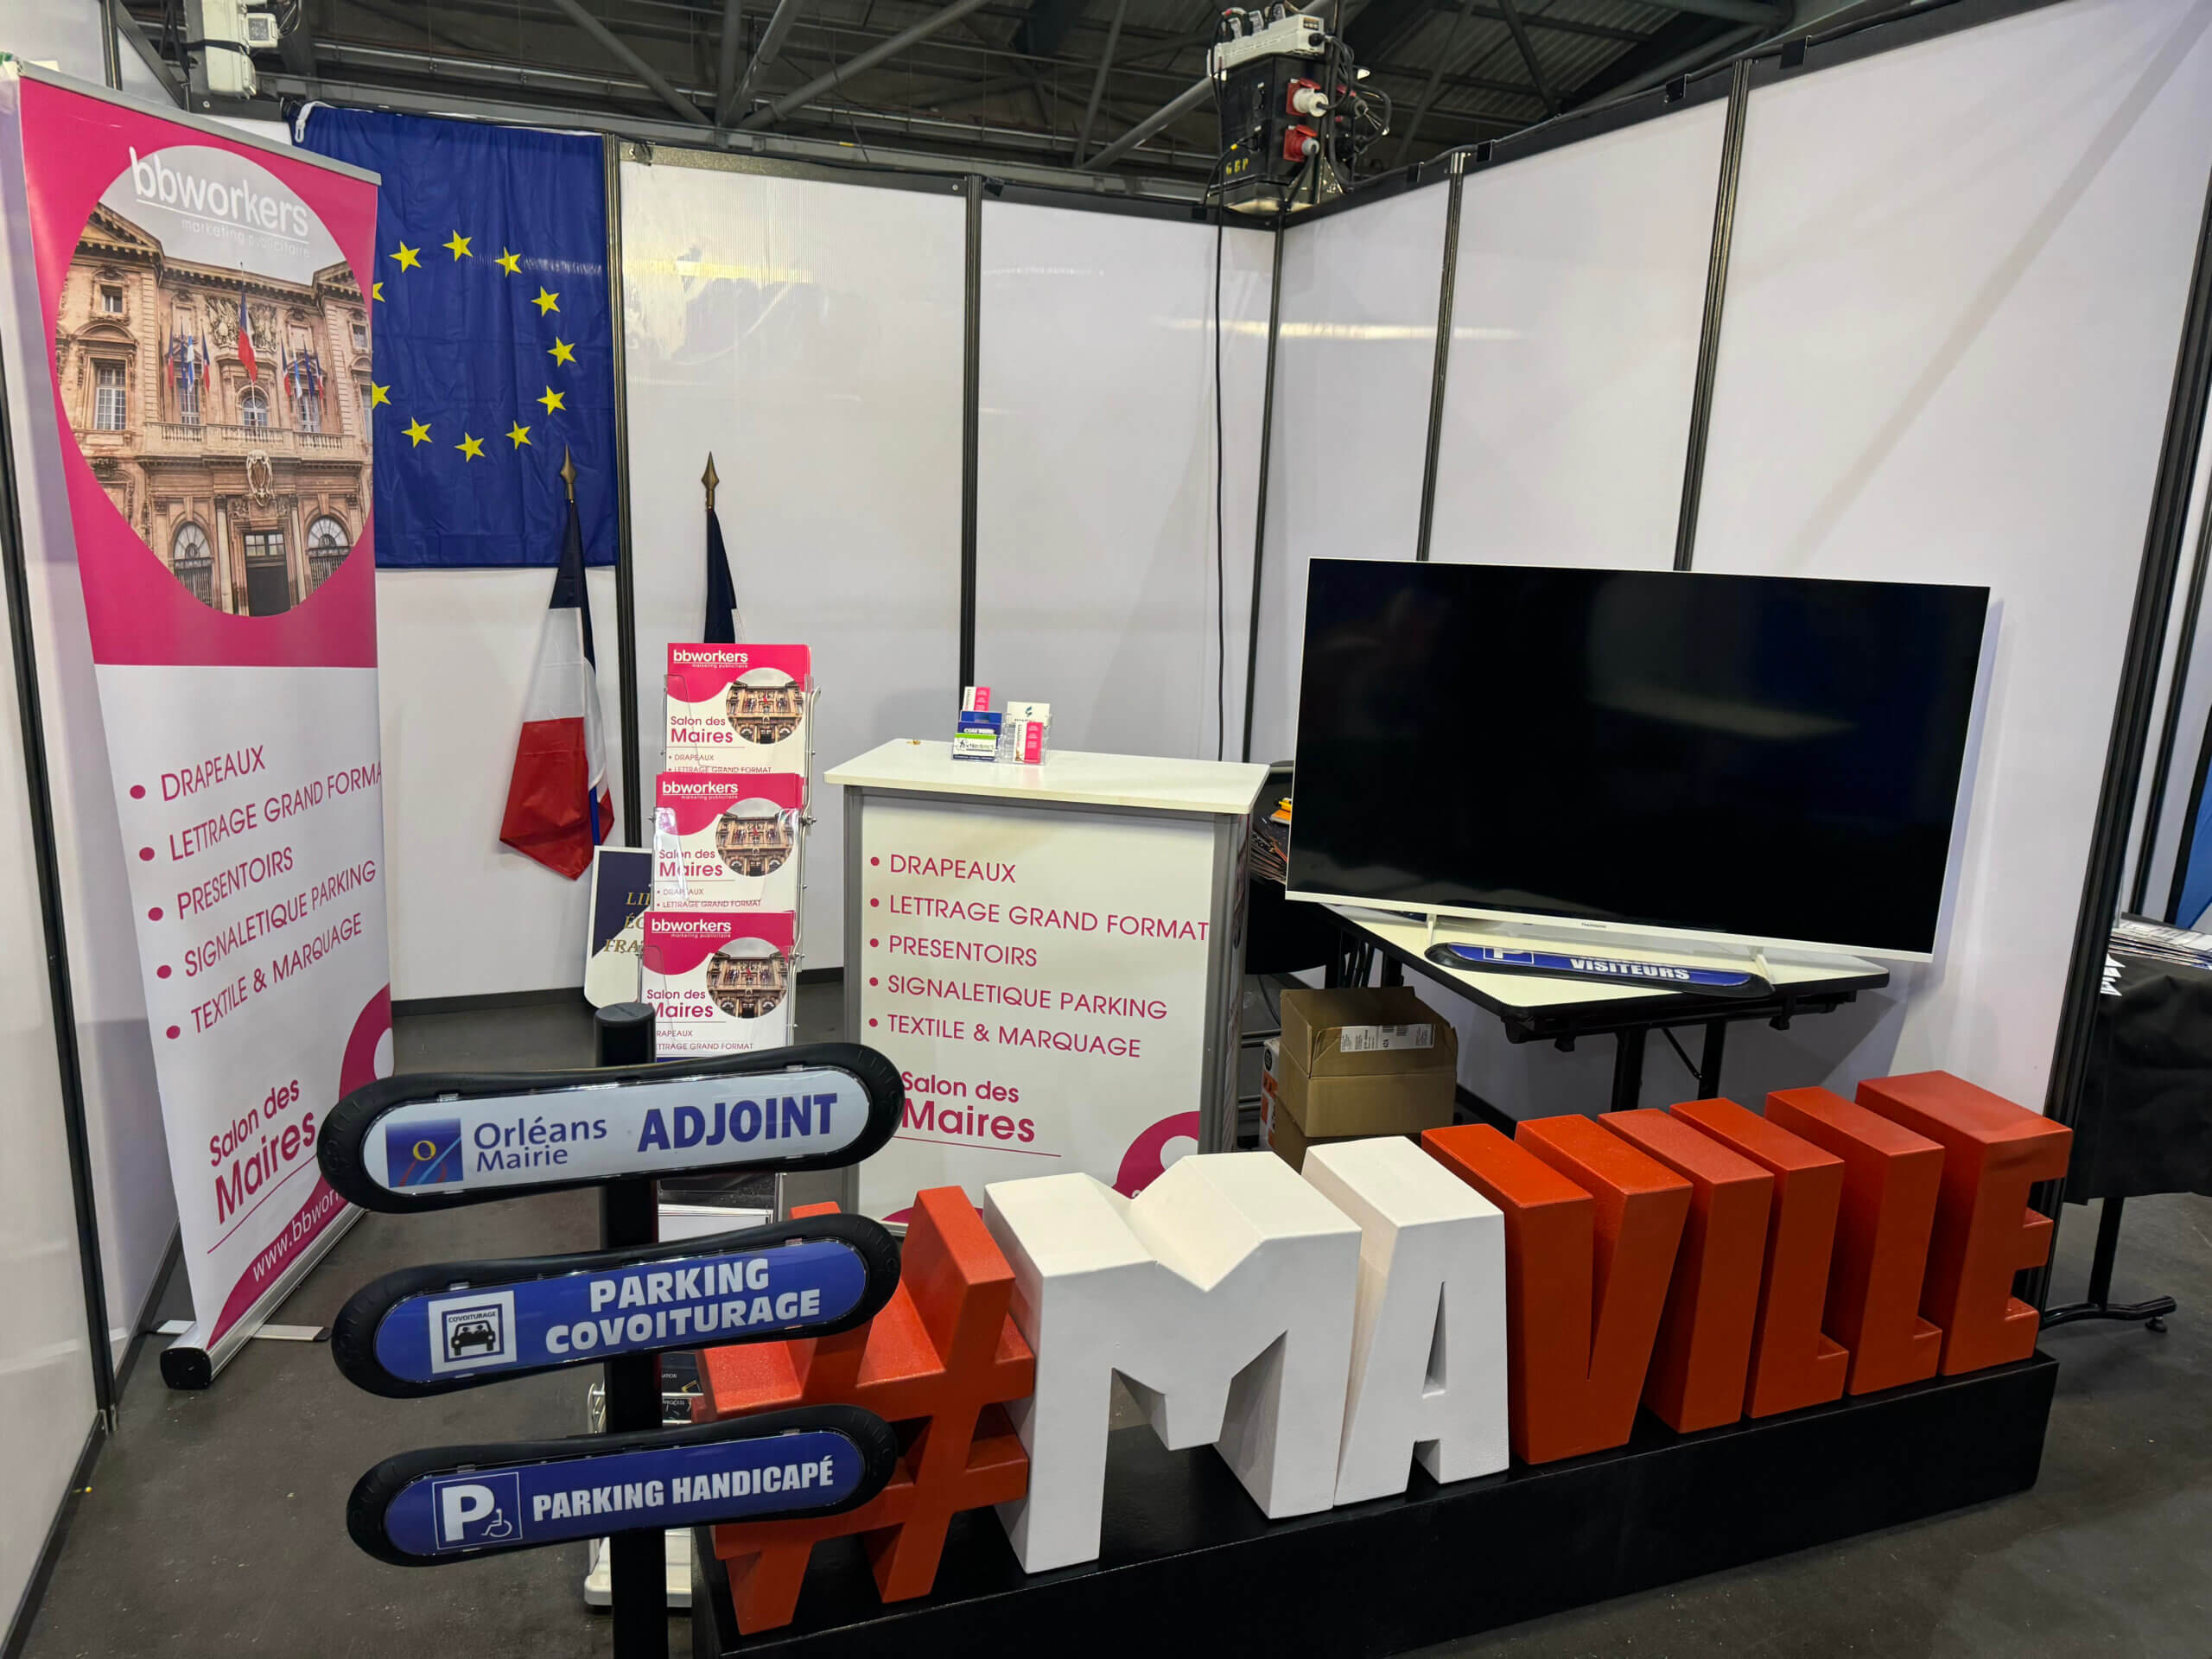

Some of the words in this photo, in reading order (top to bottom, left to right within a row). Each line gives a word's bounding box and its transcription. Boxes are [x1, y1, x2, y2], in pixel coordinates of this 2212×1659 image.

[130, 146, 308, 237] bbworkers
[673, 649, 748, 662] bbworkers
[671, 715, 702, 726] Salon
[706, 715, 726, 726] des
[671, 728, 733, 743] Maires
[161, 745, 265, 802] DRAPEAUX
[662, 780, 739, 793] bbworkers
[169, 803, 257, 861] LETTRAGE
[264, 780, 323, 823] GRAND
[695, 849, 715, 859] des
[890, 854, 1016, 884] DRAPEAUX
[177, 846, 294, 920] PRESENTOIRS
[184, 893, 308, 977] SIGNALETIQUE
[311, 860, 376, 912] PARKING
[652, 918, 731, 931] bbworkers
[890, 895, 1000, 923] LETTRAGE
[1008, 906, 1098, 931] GRAND
[1107, 914, 1209, 941] FORMAT
[190, 976, 248, 1033] TEXTILE
[253, 968, 268, 994] &
[272, 912, 362, 983] MARQUAGE
[890, 935, 1037, 967] PRESENTOIRS
[1569, 958, 1690, 981] VISITEURS
[647, 989, 680, 999] Salon
[683, 989, 706, 999] des
[887, 975, 1052, 1010] SIGNALETIQUE
[1060, 993, 1167, 1020] PARKING
[887, 1014, 965, 1039] TEXTILE
[973, 1024, 989, 1042] &
[999, 1026, 1141, 1058] MARQUAGE
[901, 1071, 967, 1097] Salon
[976, 1081, 1020, 1103] des
[210, 1108, 259, 1167] Salon
[264, 1079, 300, 1120] des
[474, 1116, 607, 1149] Orléans
[637, 1092, 838, 1153] ADJOINT
[901, 1098, 1036, 1143] Maires
[215, 1112, 316, 1224] Maires
[477, 1145, 569, 1173] Mairie
[252, 1188, 340, 1282] www.bbwor
[589, 1257, 769, 1313] PARKING
[448, 1311, 496, 1323] COVOITURAGE
[545, 1288, 821, 1354] COVOITURAGE
[532, 1480, 664, 1522] PARKING
[672, 1455, 834, 1504] HANDICAPÉ
[442, 1483, 495, 1542] P
